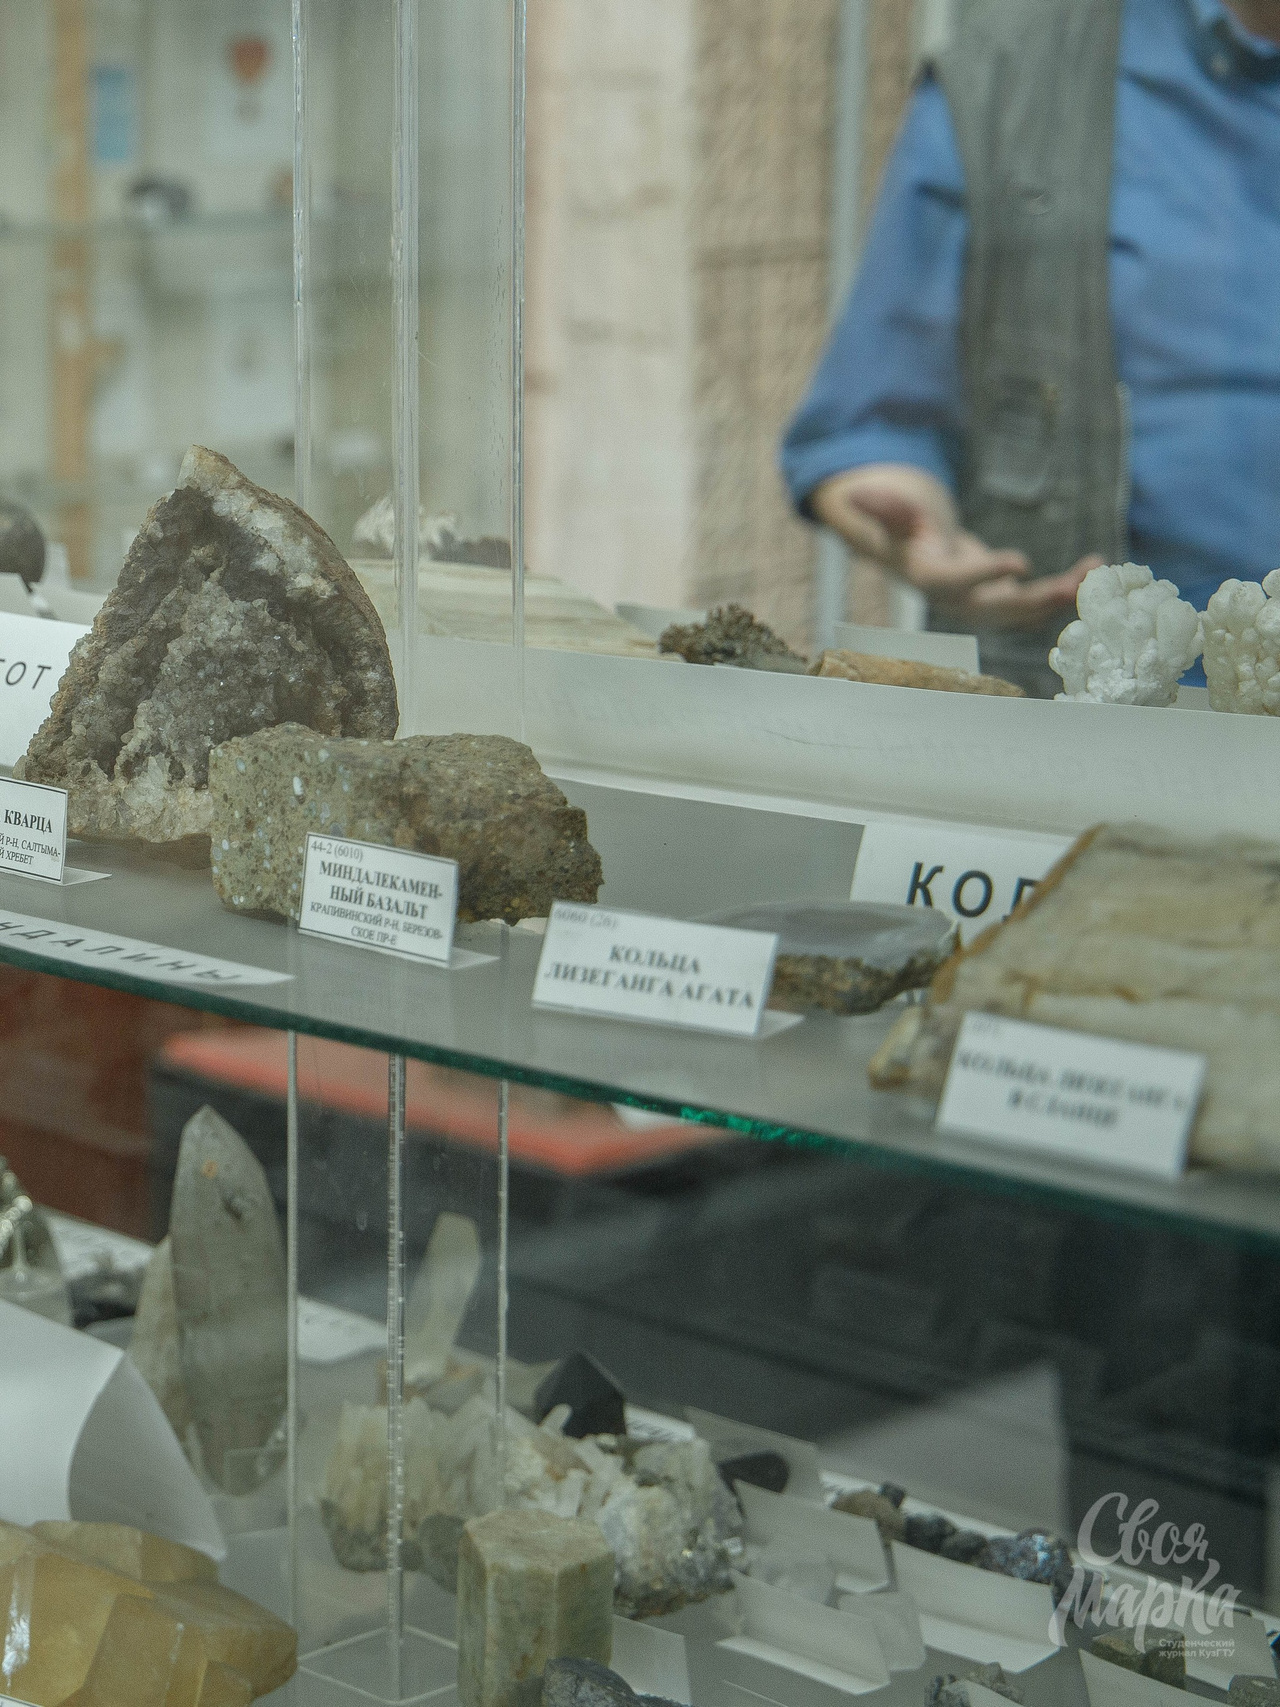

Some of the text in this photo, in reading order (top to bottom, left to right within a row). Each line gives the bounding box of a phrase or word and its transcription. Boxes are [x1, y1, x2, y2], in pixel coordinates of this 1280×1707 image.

[3, 808, 53, 835] КВАРЦА
[5, 849, 34, 866] ХРЕБЕТ
[21, 840, 61, 858] САЛТЫМА-
[310, 840, 333, 855] 44-2
[319, 859, 443, 900] МИНДАЛЕКАМЕН-
[310, 901, 382, 926] КРАПИВИНСКИЙ
[330, 885, 429, 920] НЫЙ БАЗАЛЬТ
[608, 944, 701, 975] КОЛЬЦА
[544, 961, 754, 1010] ЛИЗЕГАНГА АГАТА
